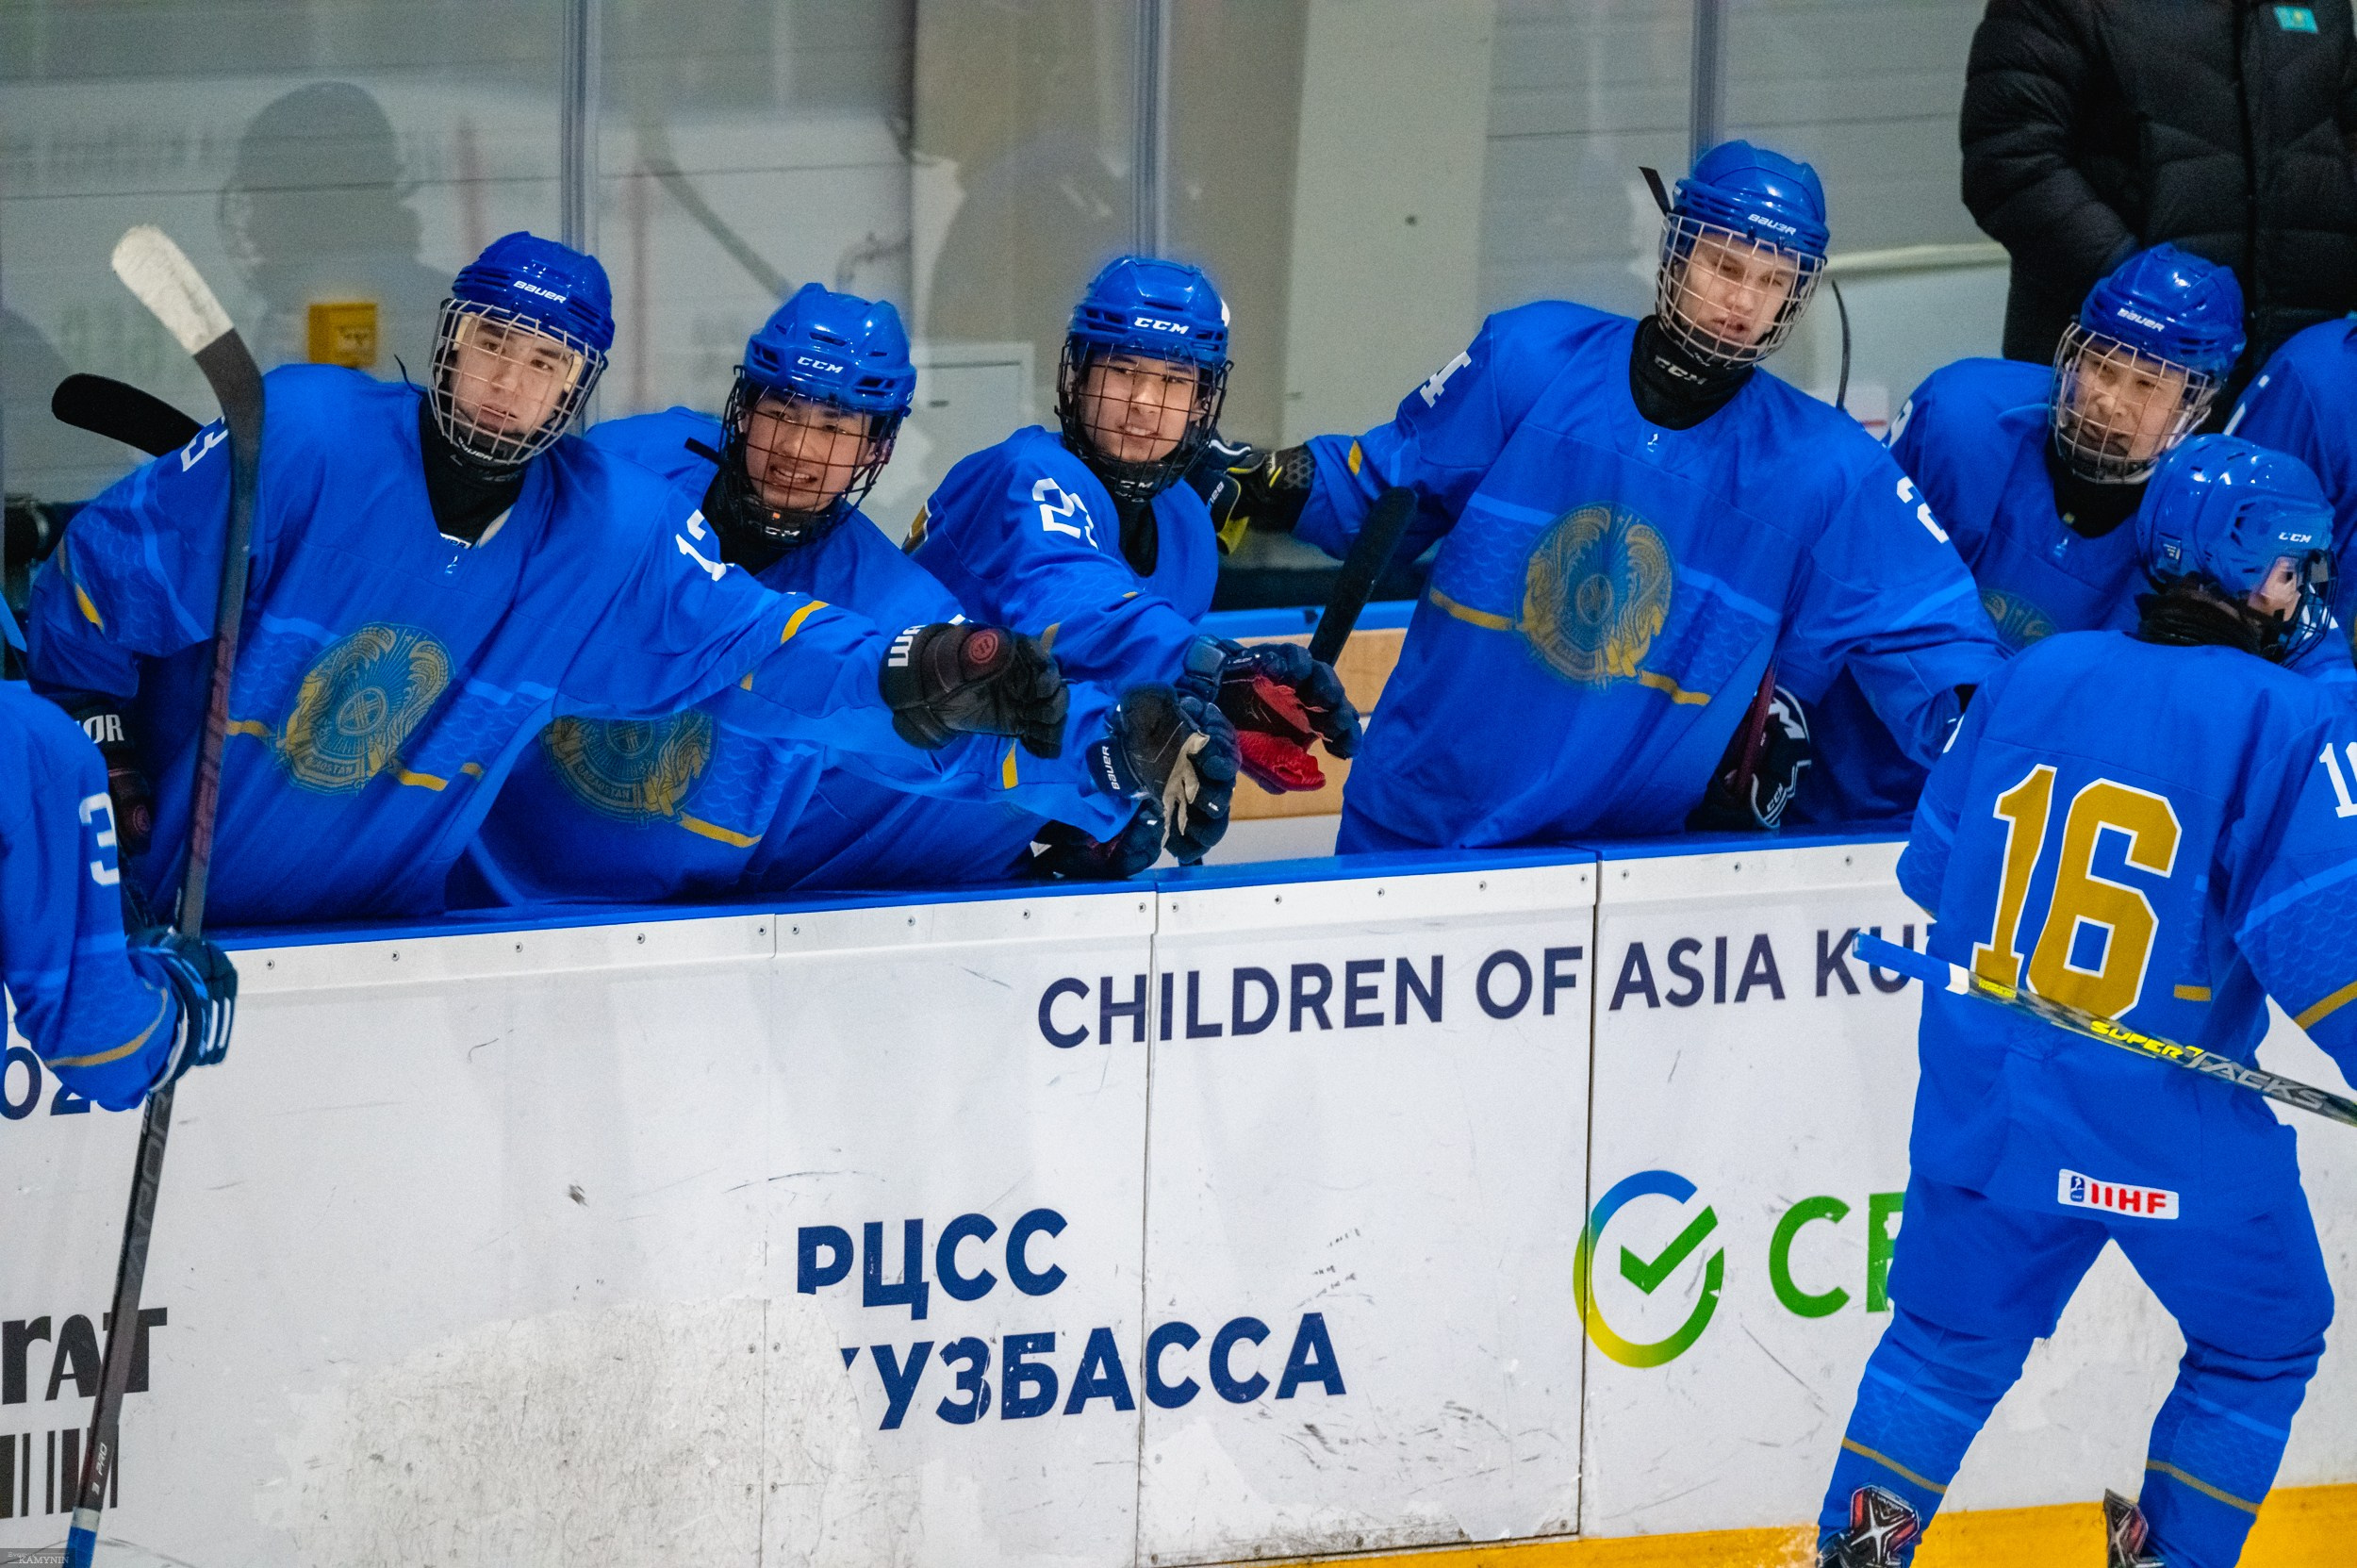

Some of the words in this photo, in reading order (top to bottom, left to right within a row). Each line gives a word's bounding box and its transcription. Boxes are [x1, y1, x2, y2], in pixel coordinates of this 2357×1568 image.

[1747, 213, 1797, 236] BAUER
[513, 280, 568, 304] BAUER
[1133, 317, 1190, 335] CCM
[2117, 307, 2166, 332] BAUER
[797, 355, 844, 374] CCM
[1655, 355, 1708, 386] CCM
[1101, 746, 1121, 790] BAUER
[1766, 782, 1785, 813] CCM
[1970, 764, 2183, 1020] 16
[1038, 953, 1443, 1049] CHILDREN
[1475, 946, 1584, 1021] OF
[1608, 933, 1787, 1012] ASIA
[1815, 923, 1935, 998] KU
[2090, 1182, 2167, 1214] IIHF
[796, 1207, 1069, 1321] РЦСС
[840, 1312, 1347, 1431] УЗБАССА
[95, 1441, 107, 1477] PRO
